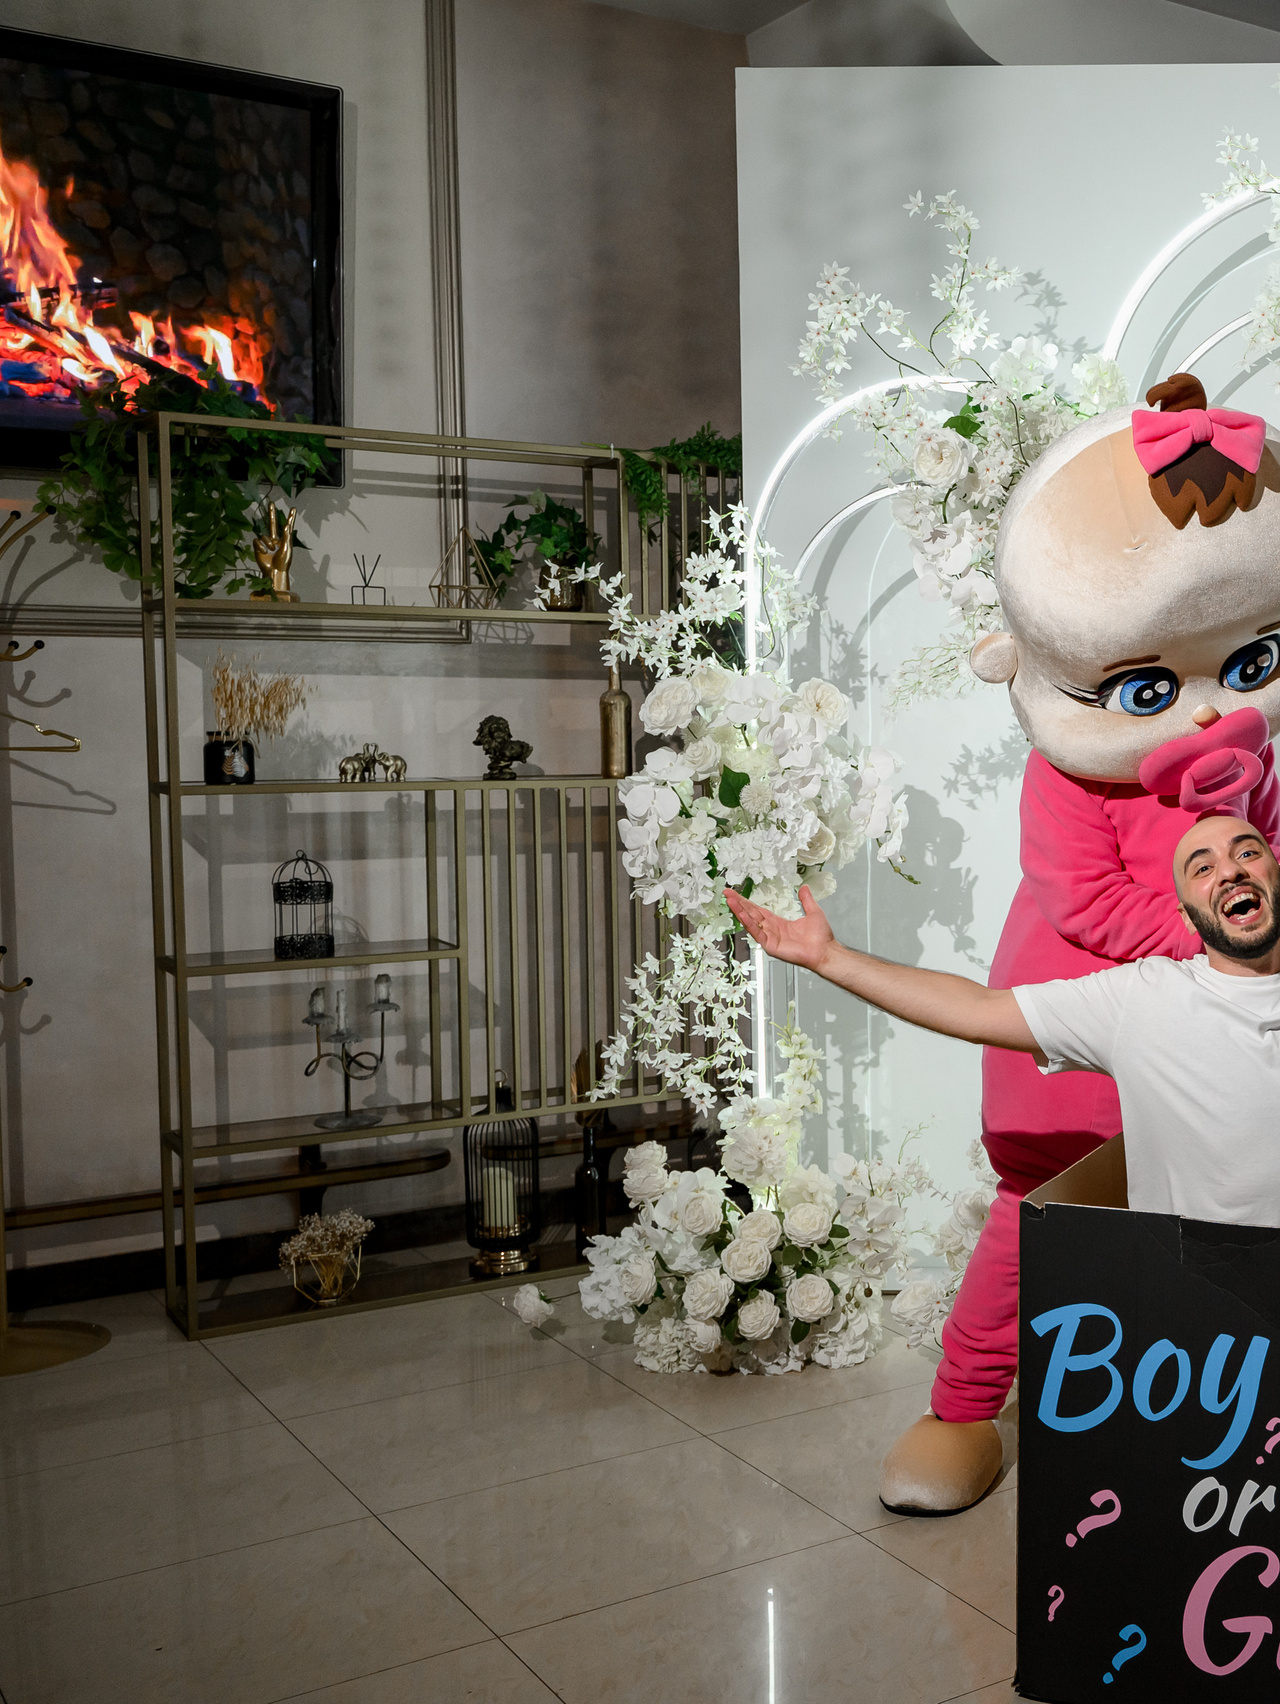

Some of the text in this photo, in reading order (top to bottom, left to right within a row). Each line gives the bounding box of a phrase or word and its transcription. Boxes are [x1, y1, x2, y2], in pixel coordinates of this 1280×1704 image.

[1029, 1302, 1271, 1470] Boy
[1065, 1489, 1122, 1548] ?
[1182, 1476, 1277, 1537] or
[1047, 1584, 1065, 1622] ?
[1102, 1624, 1147, 1685] ?
